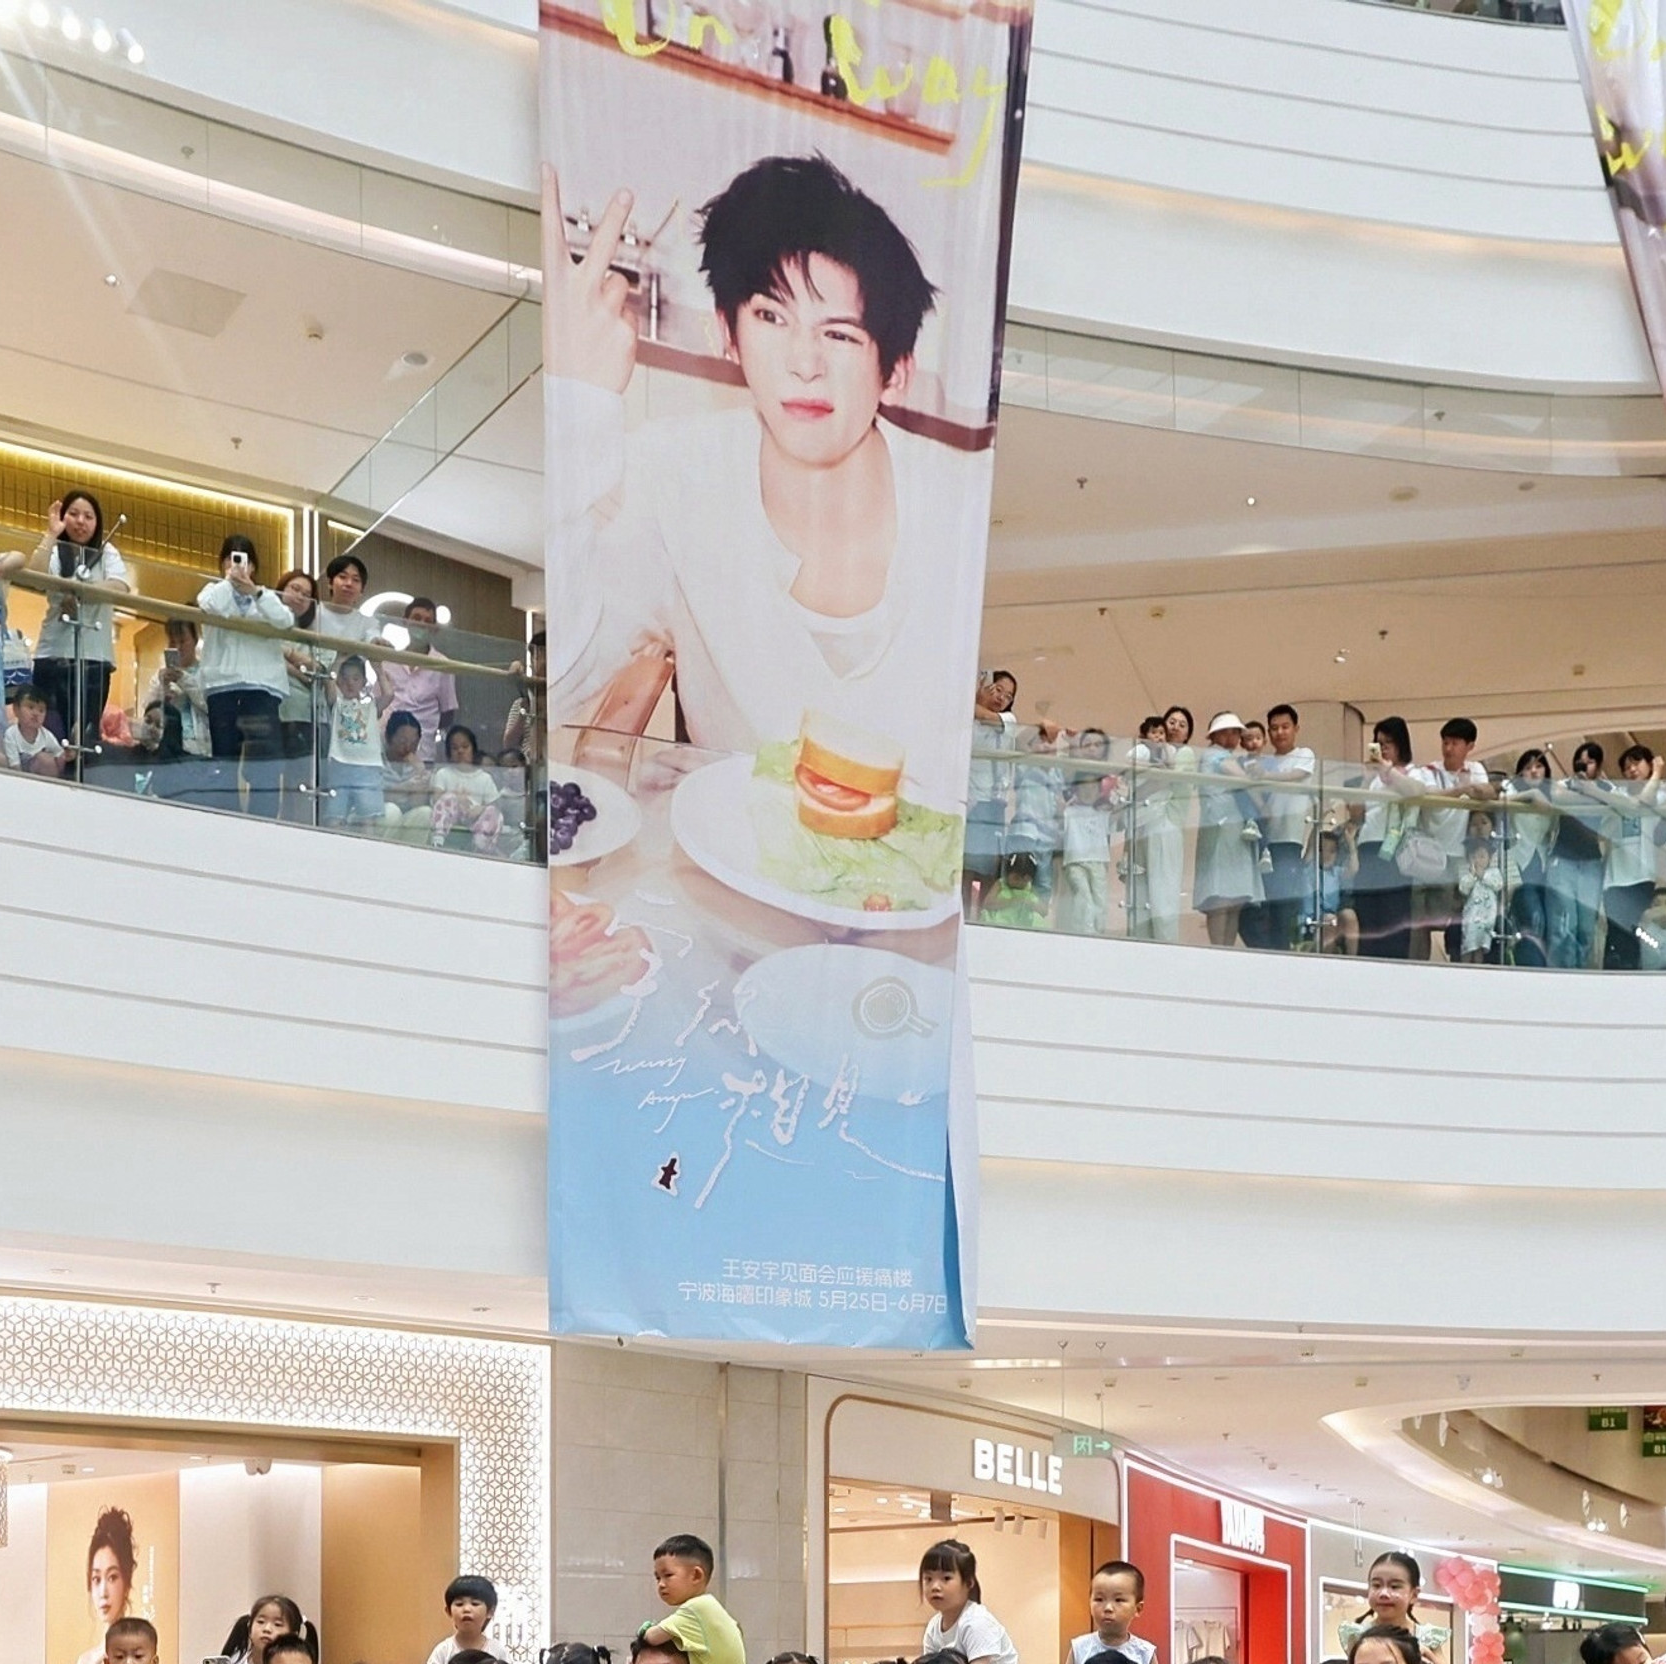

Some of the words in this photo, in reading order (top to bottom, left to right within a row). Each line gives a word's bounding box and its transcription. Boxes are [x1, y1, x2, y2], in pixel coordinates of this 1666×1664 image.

[818, 1290, 948, 1315] 5月25日-6月7日
[1654, 1444, 1666, 1455] B1
[973, 1438, 1063, 1496] BELLE
